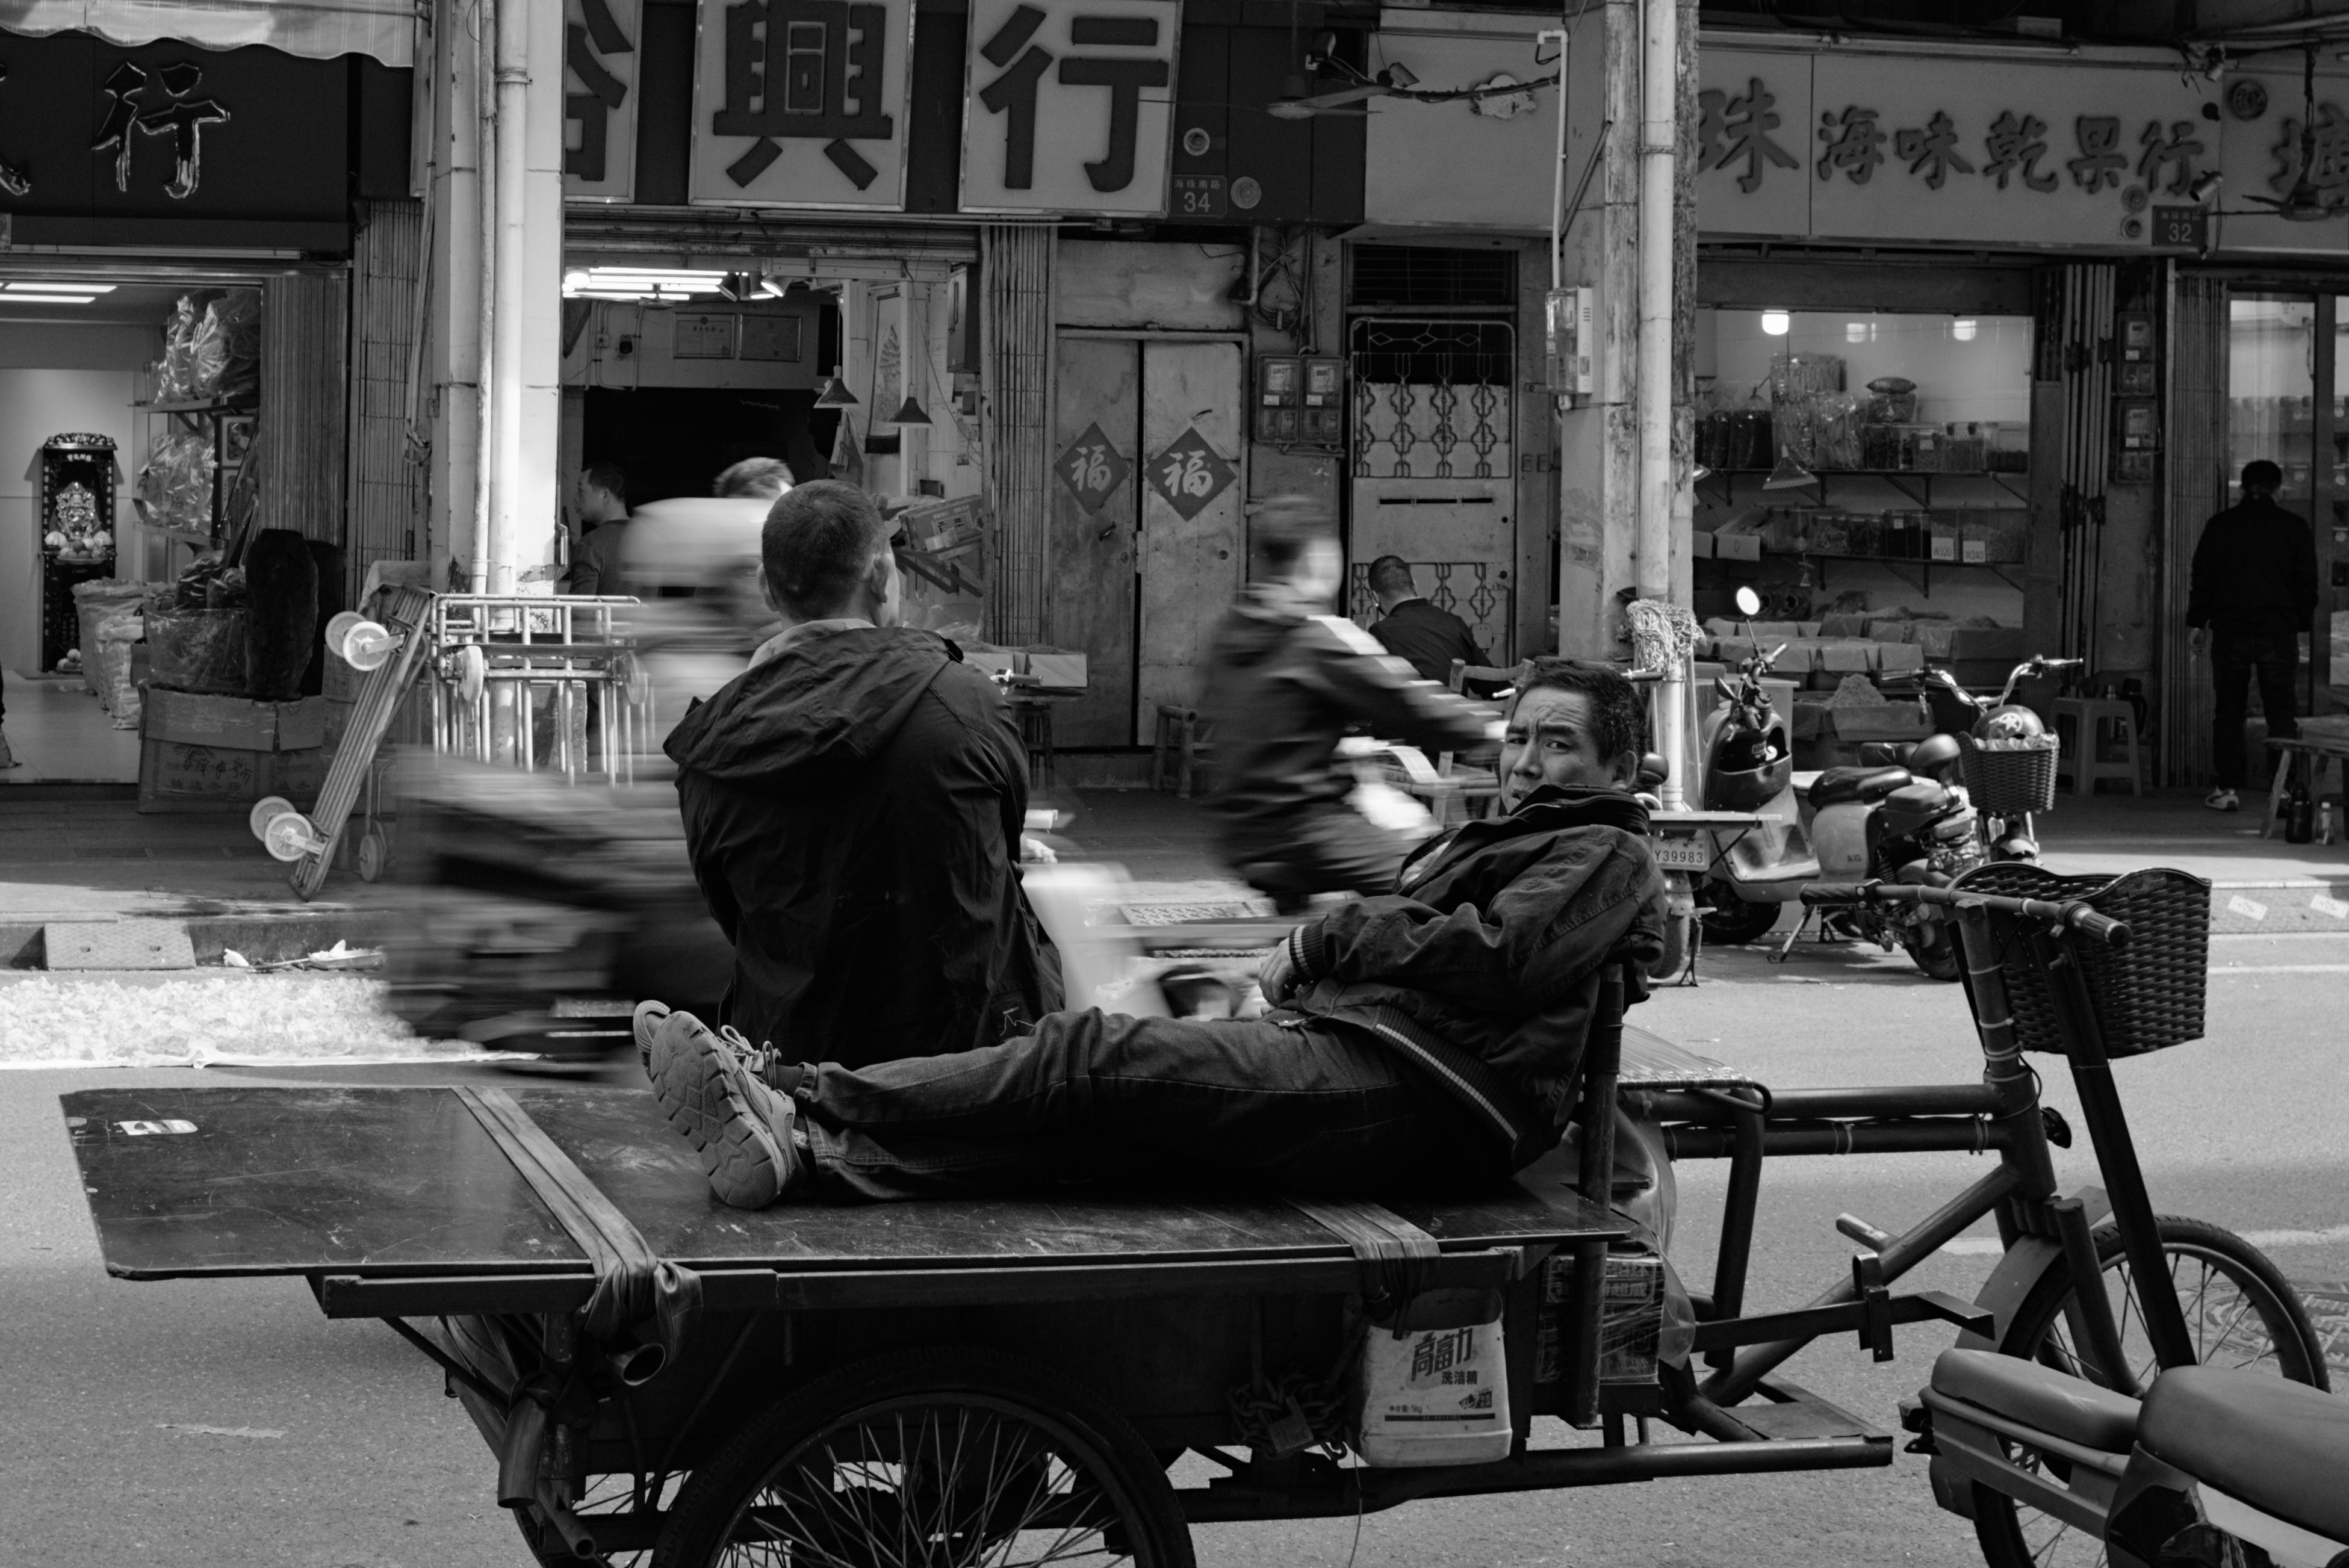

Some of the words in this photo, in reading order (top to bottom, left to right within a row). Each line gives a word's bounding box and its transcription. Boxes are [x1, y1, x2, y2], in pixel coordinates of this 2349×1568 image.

[1816, 105, 2205, 196] 海味乾果行
[1174, 178, 1220, 189] 海珠南路
[1184, 191, 1211, 212] 34
[2167, 222, 2192, 243] 32
[1070, 444, 1112, 491] 福
[1162, 450, 1214, 497] 福
[1965, 550, 1984, 560] W240
[1654, 849, 1703, 863] Y39983
[1442, 1369, 1479, 1386] 洗洁精
